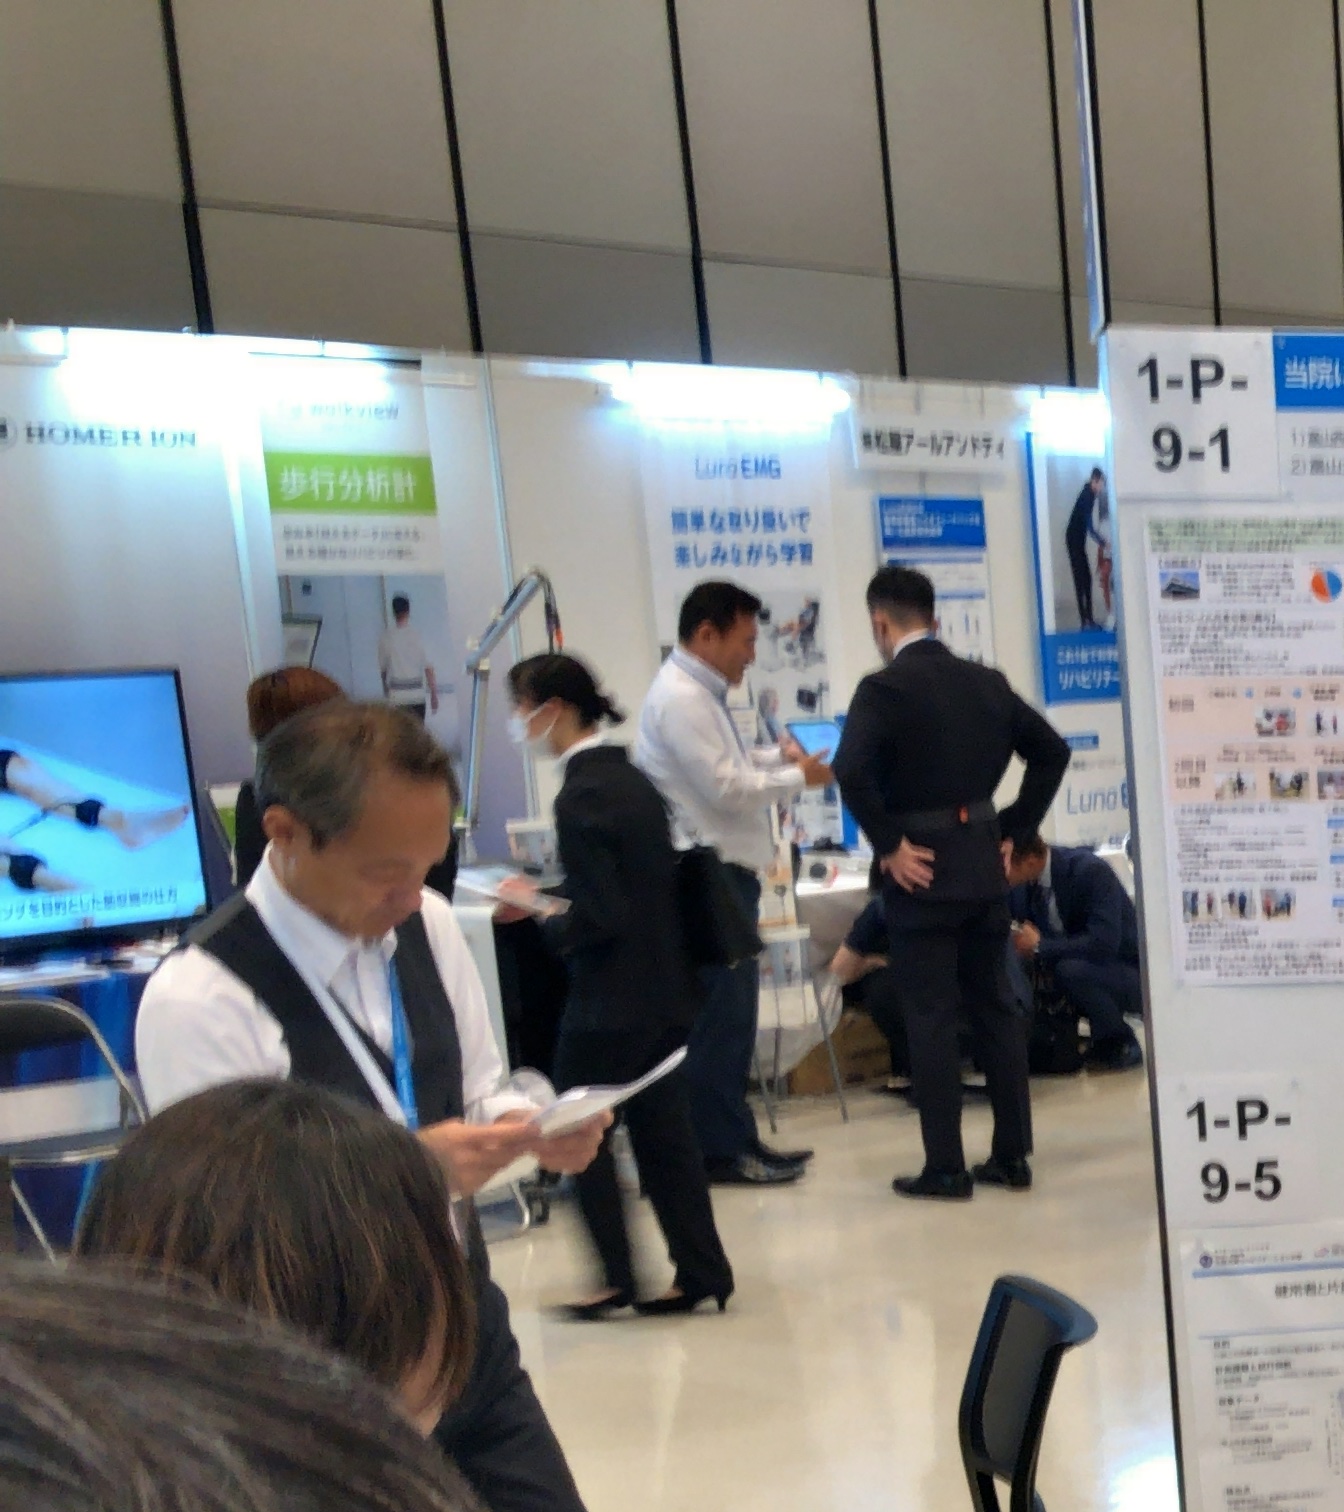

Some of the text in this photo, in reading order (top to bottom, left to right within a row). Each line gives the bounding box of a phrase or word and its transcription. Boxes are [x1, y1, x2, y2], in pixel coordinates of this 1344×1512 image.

[1138, 353, 1248, 403] 1-P-
[1152, 421, 1231, 474] 9-1
[280, 465, 416, 502] 歩行分析計
[1185, 1095, 1292, 1142] 1-P-
[1200, 1160, 1282, 1203] 9-5
